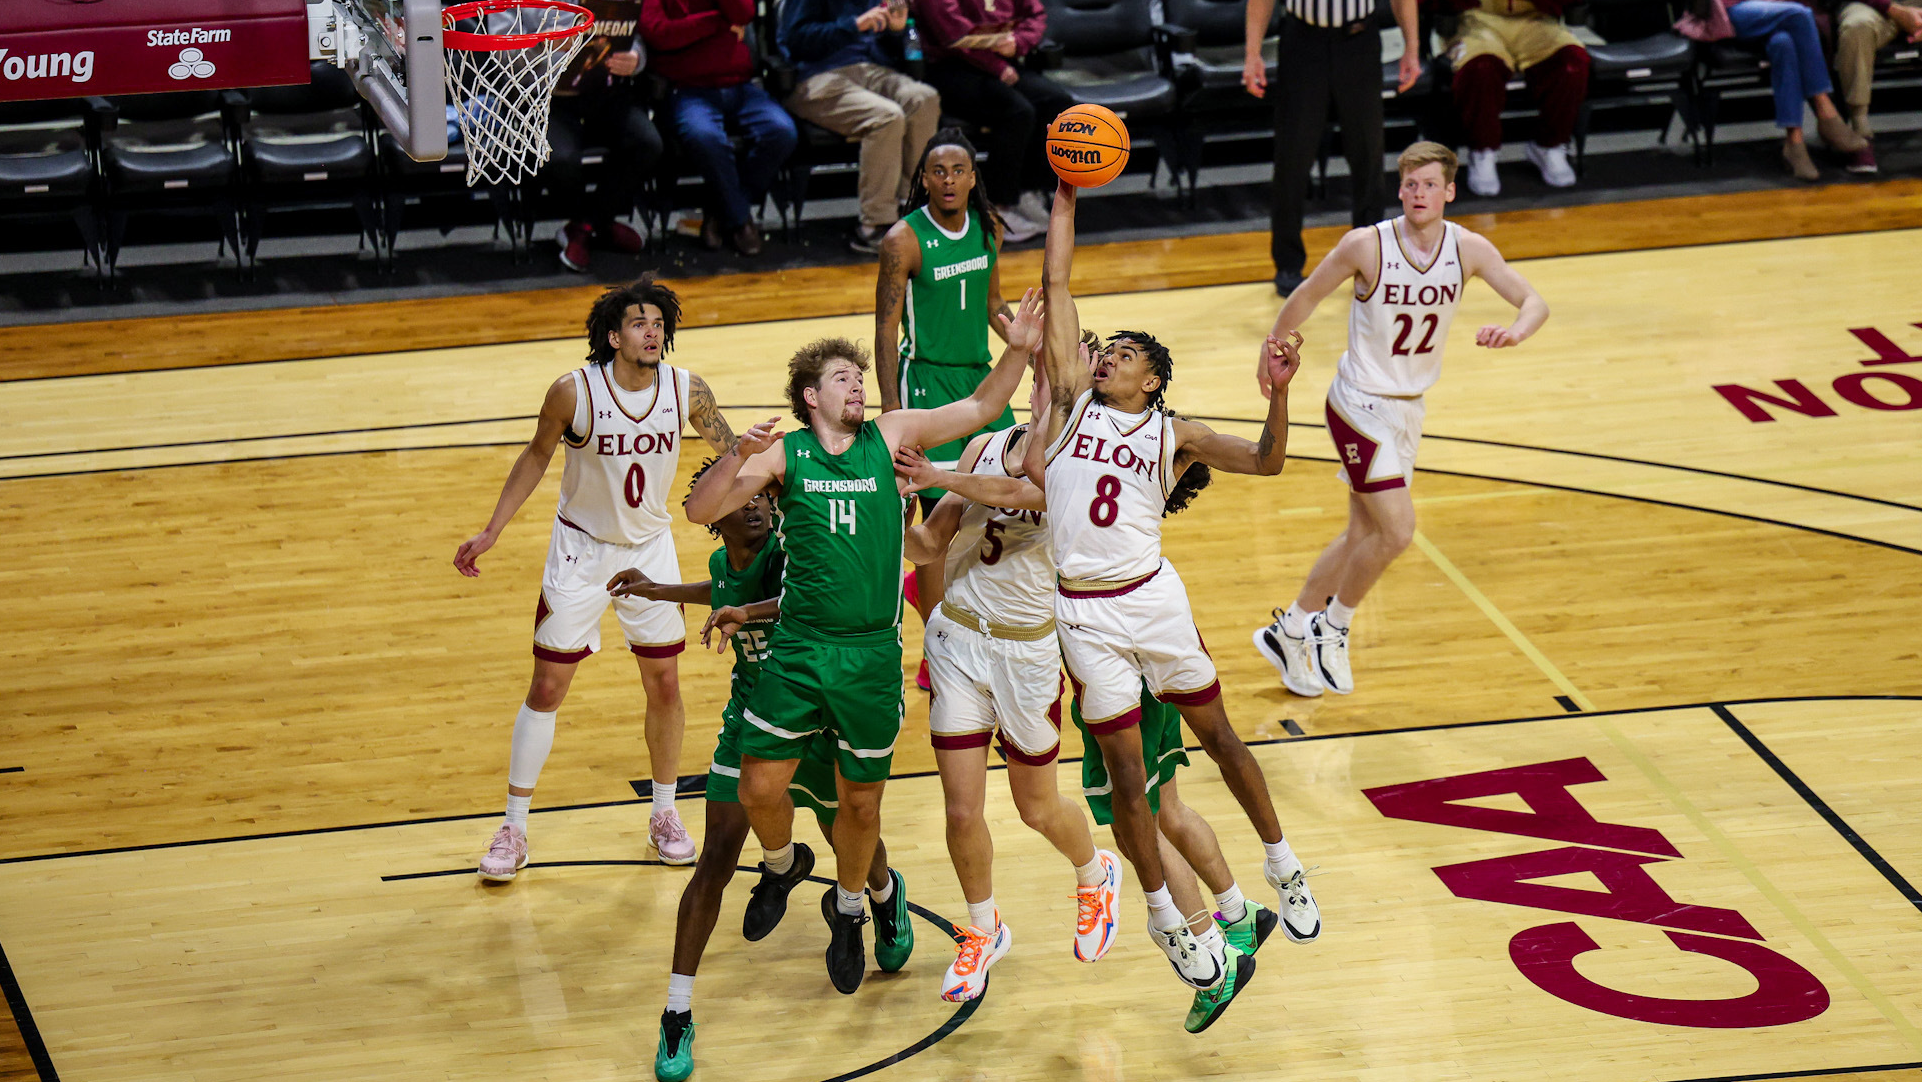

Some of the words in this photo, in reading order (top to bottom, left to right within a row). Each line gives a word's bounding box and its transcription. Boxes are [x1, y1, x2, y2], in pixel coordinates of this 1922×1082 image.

[1058, 121, 1097, 136] NCAA
[1051, 145, 1102, 164] Wilson
[933, 254, 988, 281] GREENSBORO
[960, 279, 966, 310] 1
[1382, 283, 1458, 306] ELON
[1391, 313, 1439, 357] 22
[596, 431, 676, 456] ELON
[1070, 433, 1158, 482] ELON
[1345, 443, 1361, 464] E
[624, 462, 645, 508] 0
[802, 477, 878, 493] GREENSBORO
[828, 498, 856, 535] 14
[1089, 474, 1122, 528] 8
[980, 517, 1007, 566] 5
[736, 630, 769, 662] 25
[1361, 756, 1830, 1028] CAA
